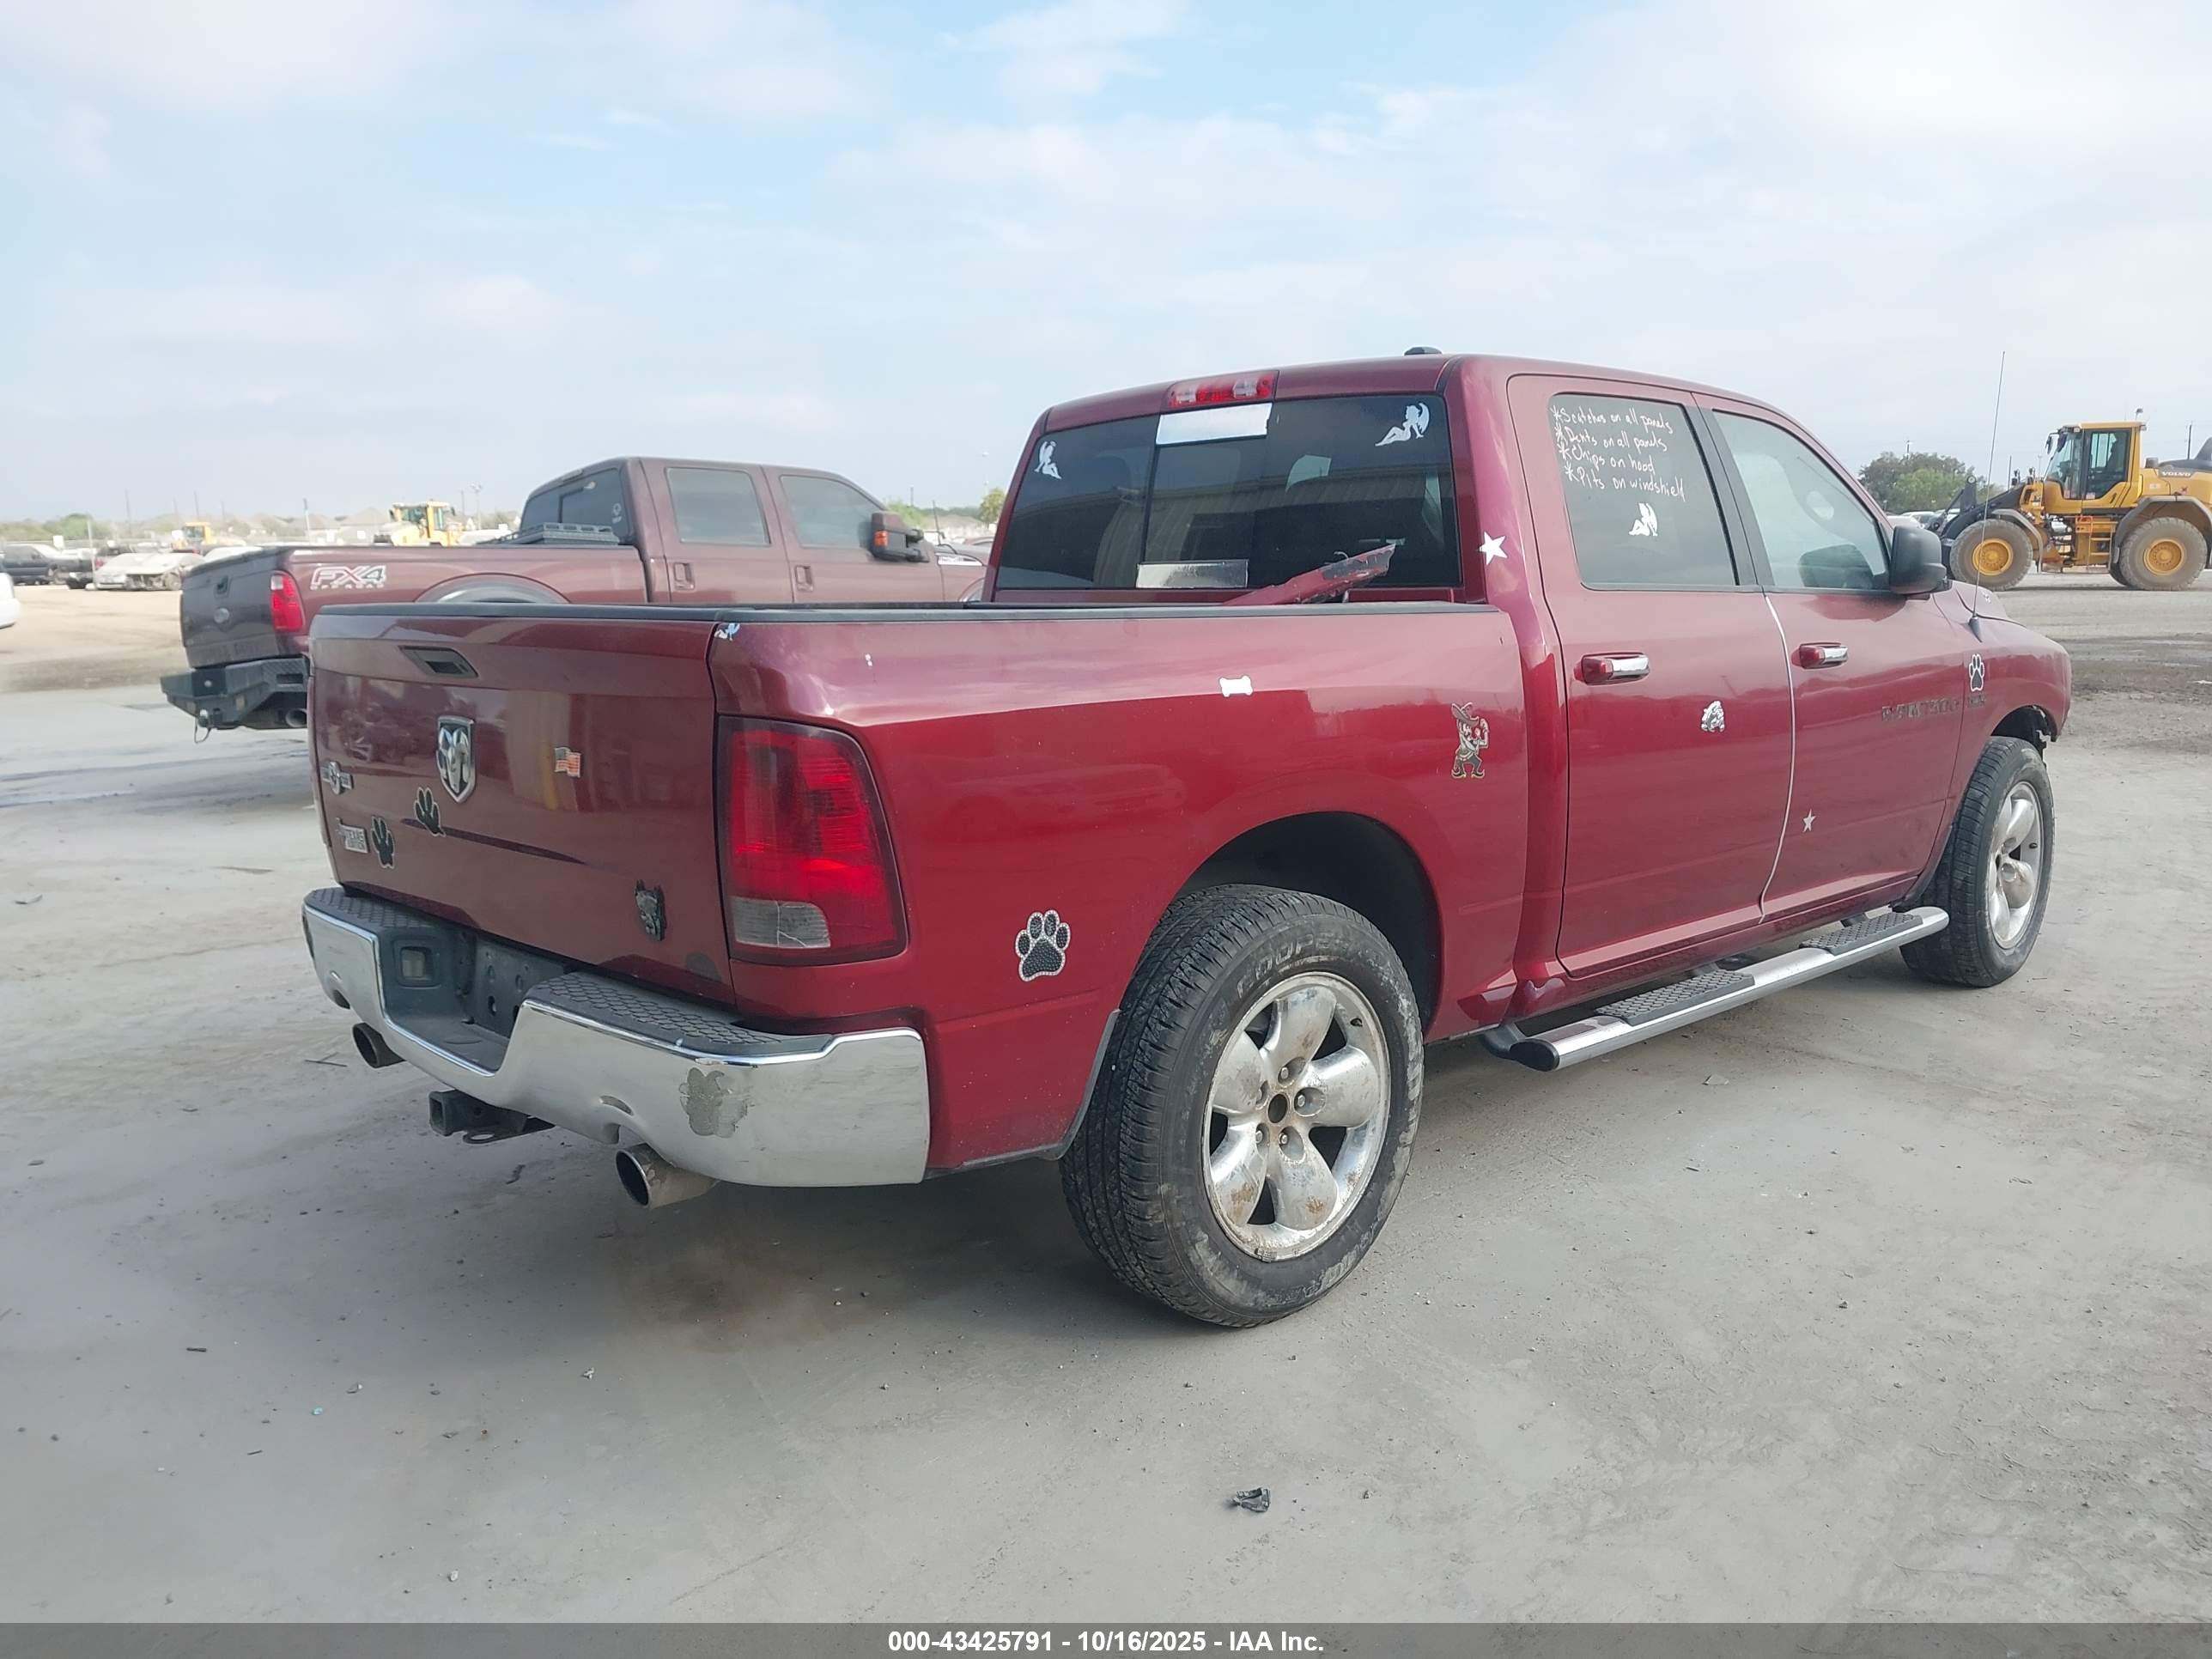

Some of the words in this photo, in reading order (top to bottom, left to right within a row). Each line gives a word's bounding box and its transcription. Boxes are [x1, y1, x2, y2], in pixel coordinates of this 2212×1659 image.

[1610, 414, 1622, 423] on
[1626, 407, 1638, 426] all
[1639, 412, 1674, 434] panels
[1603, 437, 1614, 449] on
[1617, 430, 1630, 448] all
[1633, 430, 1668, 454] panels
[1610, 456, 1626, 468] on
[1627, 453, 1656, 476] hood
[1613, 477, 1626, 489] on
[311, 565, 386, 586] FX4
